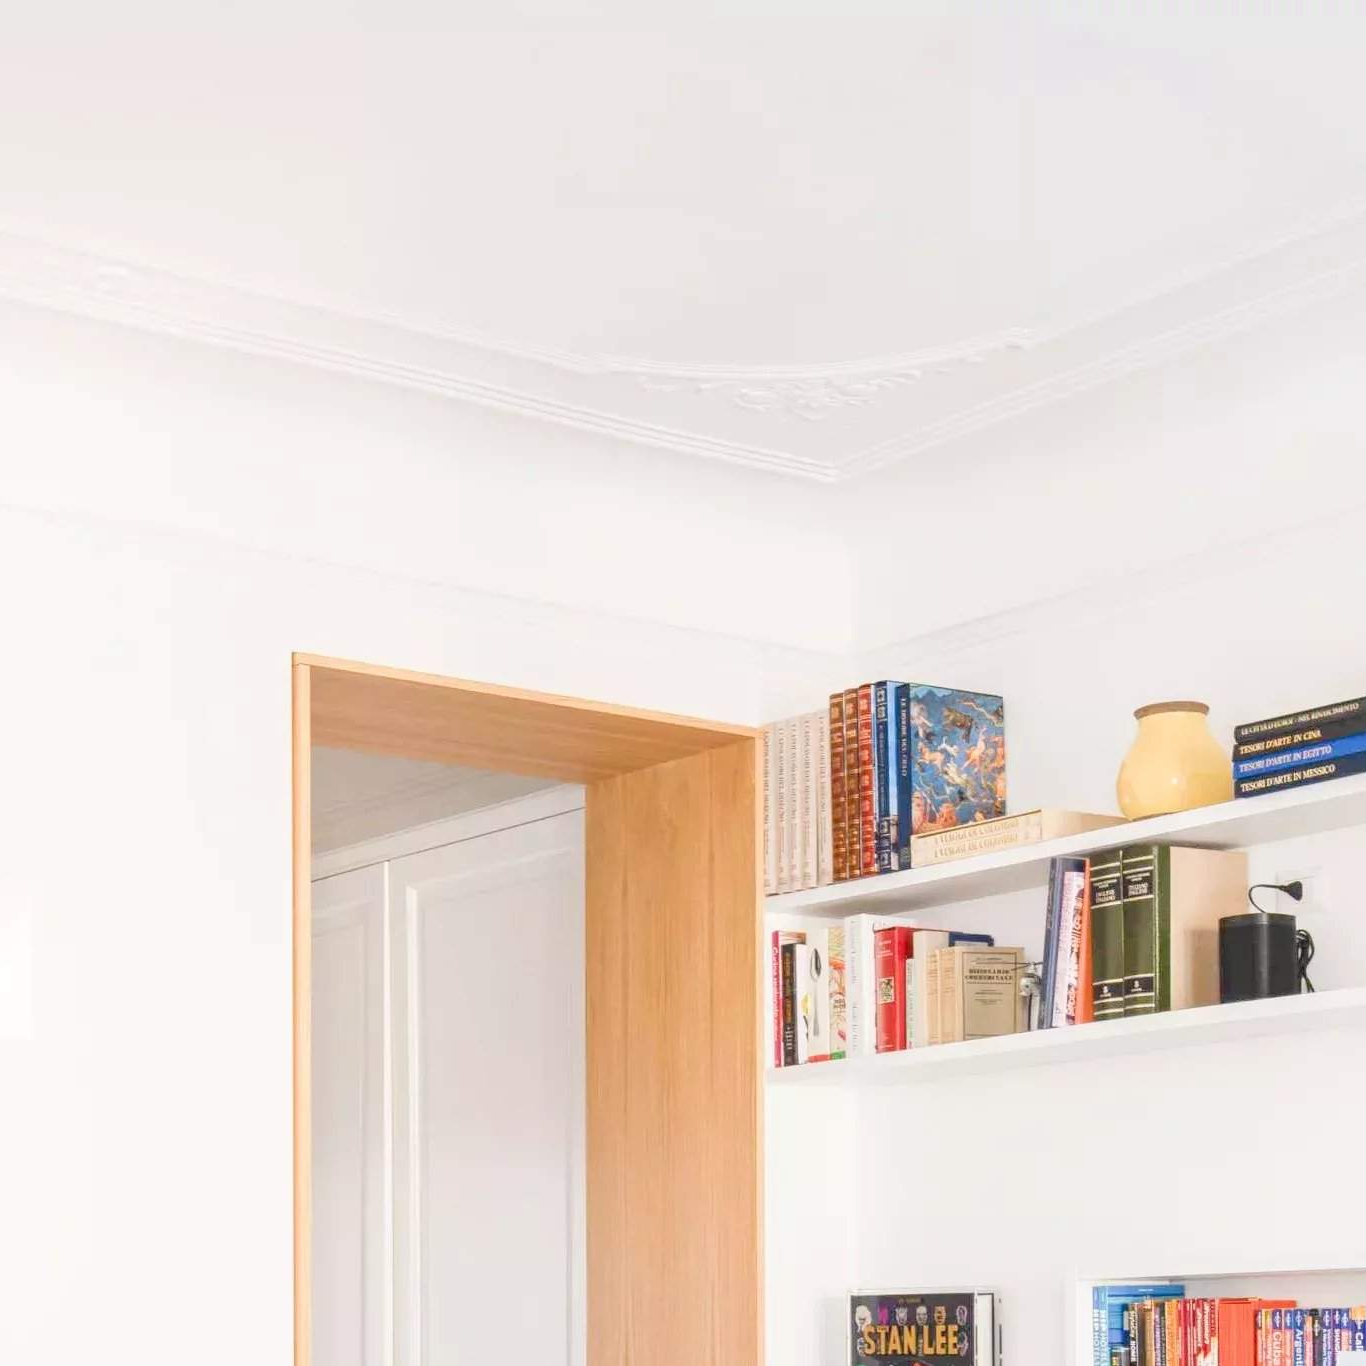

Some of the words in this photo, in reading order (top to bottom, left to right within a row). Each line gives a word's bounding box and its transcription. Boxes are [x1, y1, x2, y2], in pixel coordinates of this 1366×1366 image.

[1240, 740, 1265, 755] TESORI
[1265, 734, 1293, 749] D'ARTE
[1293, 733, 1302, 744] IN
[1303, 729, 1322, 740] CINA
[1240, 759, 1265, 772] TESORI
[1265, 753, 1293, 767] D'ARTE
[1293, 750, 1302, 761] IN
[1303, 744, 1333, 760] EGITTO
[1240, 779, 1266, 792] TESORI
[1266, 772, 1293, 787] D'ARTE
[1293, 770, 1302, 781] IN
[1302, 763, 1335, 780] MESSICO
[863, 1325, 917, 1356] STAN
[922, 1325, 959, 1356] LEE
[1273, 1331, 1283, 1366] Cuba
[1355, 1332, 1364, 1351] Cali
